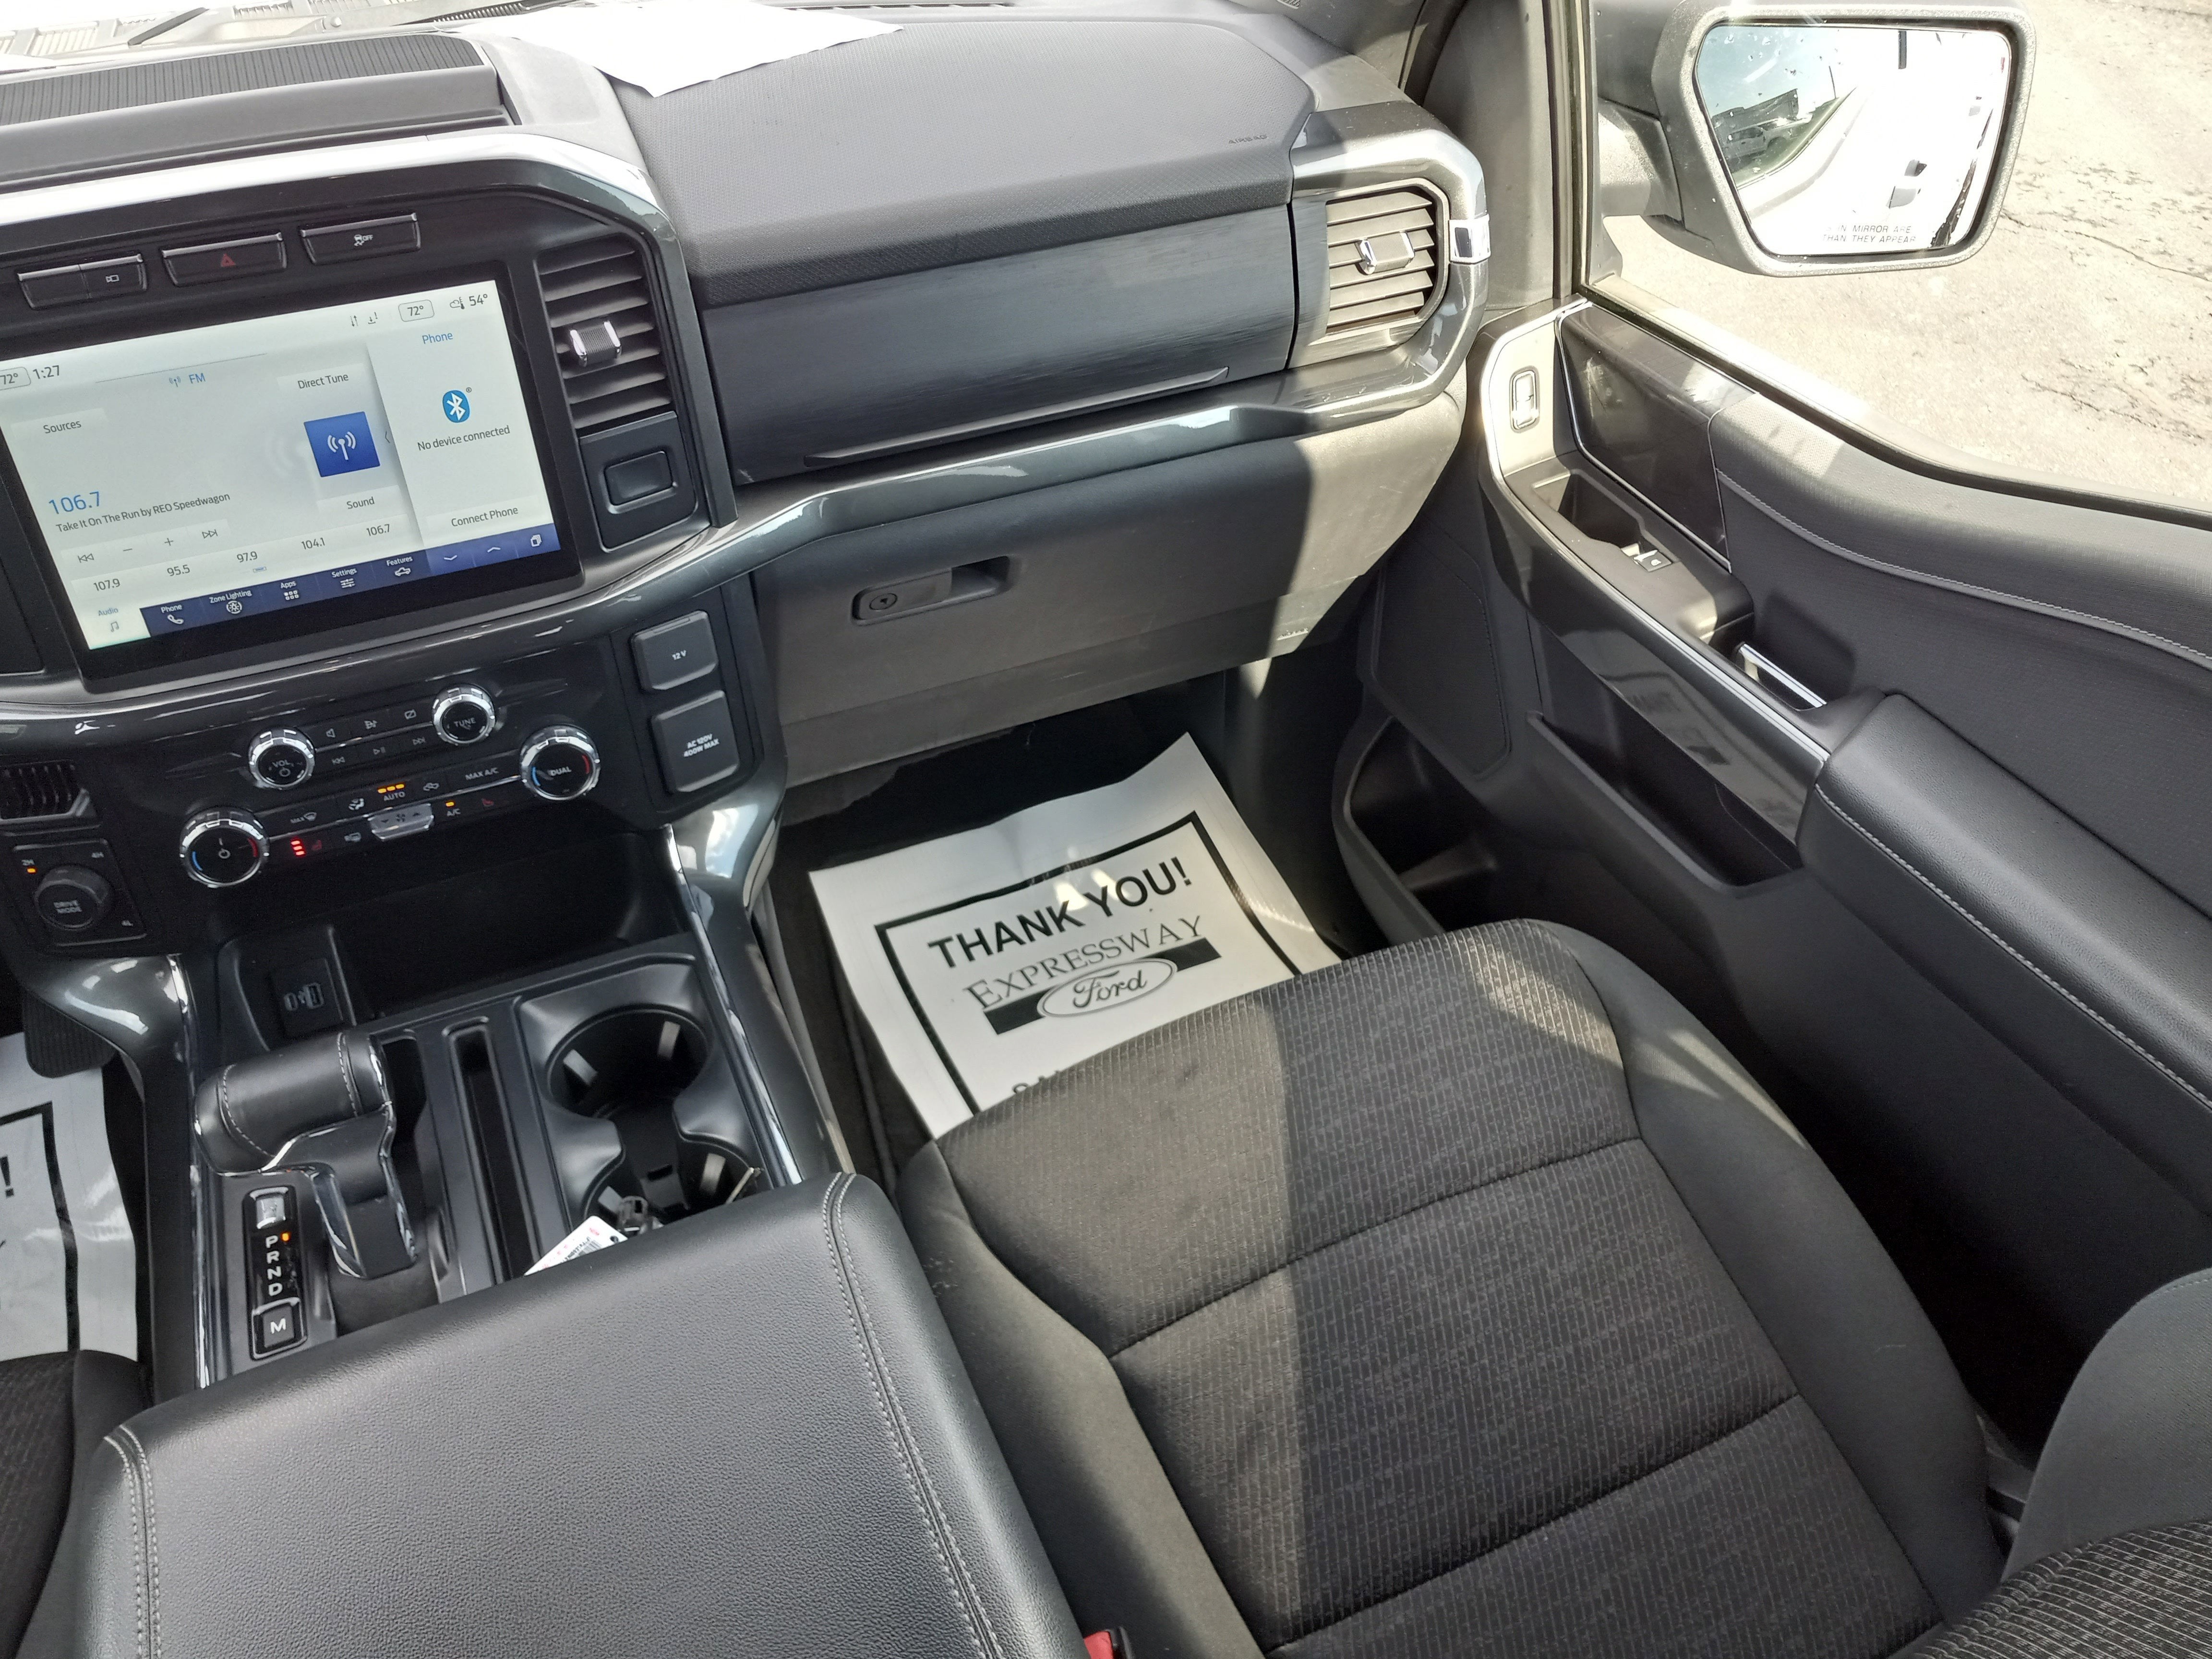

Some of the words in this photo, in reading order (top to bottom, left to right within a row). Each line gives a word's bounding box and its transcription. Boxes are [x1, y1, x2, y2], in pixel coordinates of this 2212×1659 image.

[1228, 134, 1268, 144] AIRBAG
[1852, 225, 1889, 233] MIRROR
[1822, 234, 1847, 242] THAN
[1879, 235, 1916, 243] APPEAR
[422, 331, 453, 344] Phone
[32, 365, 60, 380] 1:27
[189, 373, 206, 384] FM
[297, 375, 325, 390] Direct
[325, 373, 349, 385] Tune
[43, 420, 82, 434] Sources
[417, 441, 432, 451] No
[433, 433, 462, 448] device
[463, 425, 510, 443] connected
[48, 491, 100, 515] 106.7
[347, 496, 375, 510] Sound
[56, 521, 79, 533] Take
[80, 519, 87, 529] It
[88, 517, 102, 527] On
[102, 514, 120, 524] The
[121, 511, 140, 520] Run
[140, 508, 152, 518] by
[152, 505, 173, 515] REO
[173, 493, 231, 512] Speedwagon
[451, 512, 489, 528] Connect
[489, 505, 519, 521] Phone
[366, 524, 391, 537] 106.7
[301, 538, 325, 550] 104.1
[237, 551, 258, 563] 97.9
[386, 555, 413, 566] Features
[167, 564, 191, 577] 95.5
[332, 566, 357, 578] Settings
[93, 578, 120, 592] 107.9
[280, 579, 297, 590] Apps
[209, 595, 226, 604] Zone
[226, 589, 252, 601] Lighting
[98, 607, 119, 616] Audio
[160, 603, 182, 614] Phone
[672, 652, 681, 661] 12
[453, 717, 476, 728] TUNE
[683, 745, 703, 757] 400W
[703, 738, 720, 750] MAX
[687, 739, 697, 749] AC
[697, 733, 712, 745] 120V
[465, 771, 484, 781] MAX
[484, 767, 499, 776] A/C
[549, 766, 572, 776] DUAL
[384, 791, 406, 802] AUTO
[446, 808, 461, 817] A/C
[928, 900, 1086, 969] THANK
[1085, 856, 1193, 919] YOU!
[963, 915, 1202, 1010] EXPRESSWAY
[1071, 969, 1148, 1009] Ford
[265, 1235, 279, 1249] P
[266, 1250, 280, 1264] R
[267, 1265, 282, 1280] N
[268, 1282, 283, 1296] D
[270, 1317, 287, 1334] M
